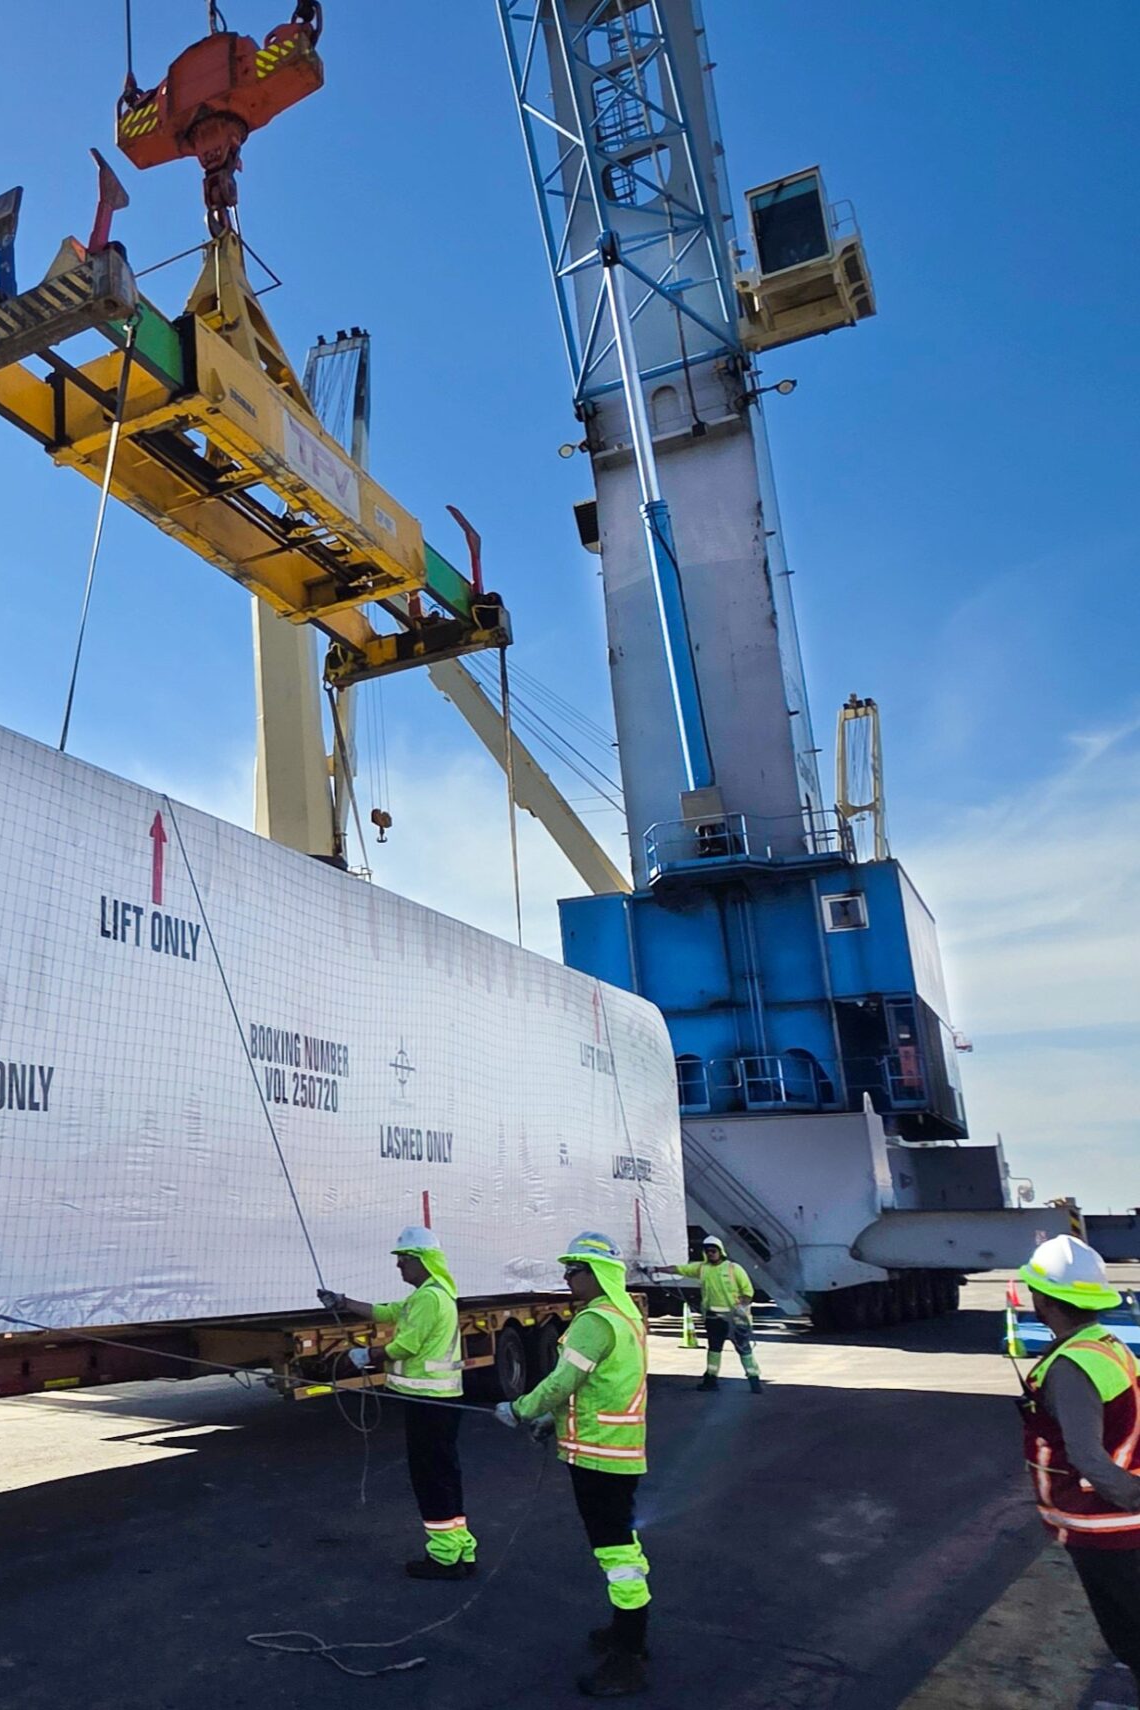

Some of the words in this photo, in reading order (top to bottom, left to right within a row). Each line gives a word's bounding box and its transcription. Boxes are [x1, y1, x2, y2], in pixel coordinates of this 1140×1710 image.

[101, 895, 144, 948] LIFT
[151, 911, 200, 962] ONLY
[250, 1023, 301, 1068] BOOKING
[304, 1035, 349, 1078] NUMBER
[265, 1066, 289, 1104] VOL
[292, 1071, 338, 1113] 250720
[380, 1124, 423, 1162] LASHED
[426, 1130, 453, 1163] ONLY
